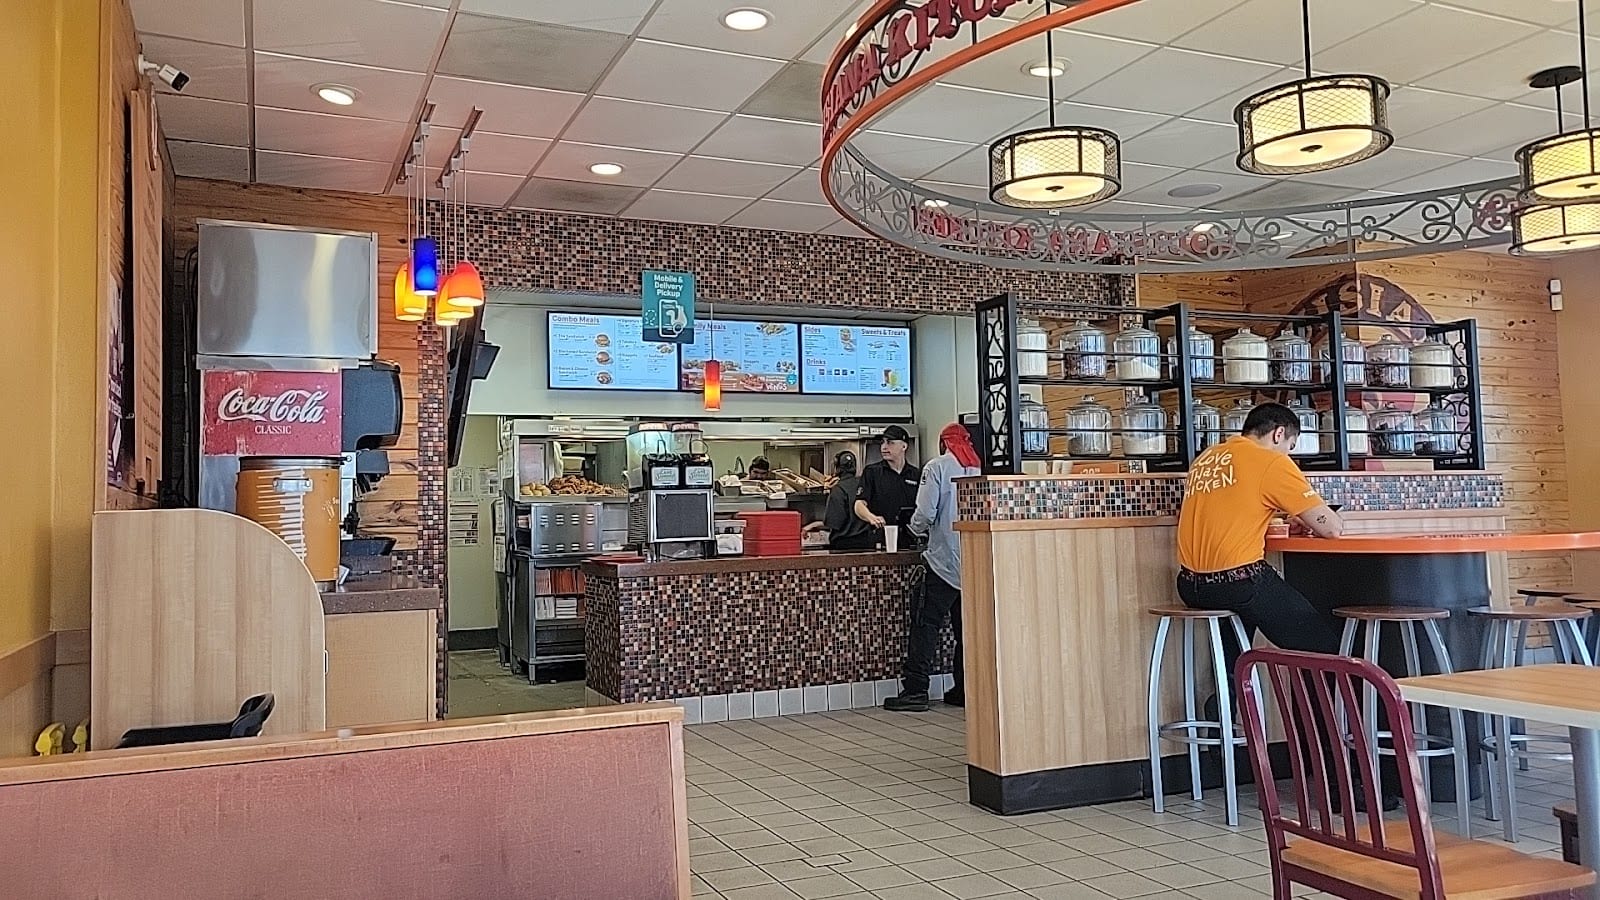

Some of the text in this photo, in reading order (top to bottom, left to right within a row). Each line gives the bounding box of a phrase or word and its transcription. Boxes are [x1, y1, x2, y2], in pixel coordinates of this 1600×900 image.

[654, 274, 677, 283] Mobile
[654, 281, 684, 291] Delivery
[656, 289, 681, 298] Pickup
[552, 315, 600, 324] Combo Meals
[861, 328, 882, 336] Sweets
[806, 358, 826, 366] Drinks
[217, 388, 329, 423] Coca-Cola
[254, 425, 292, 435] CLASSIC
